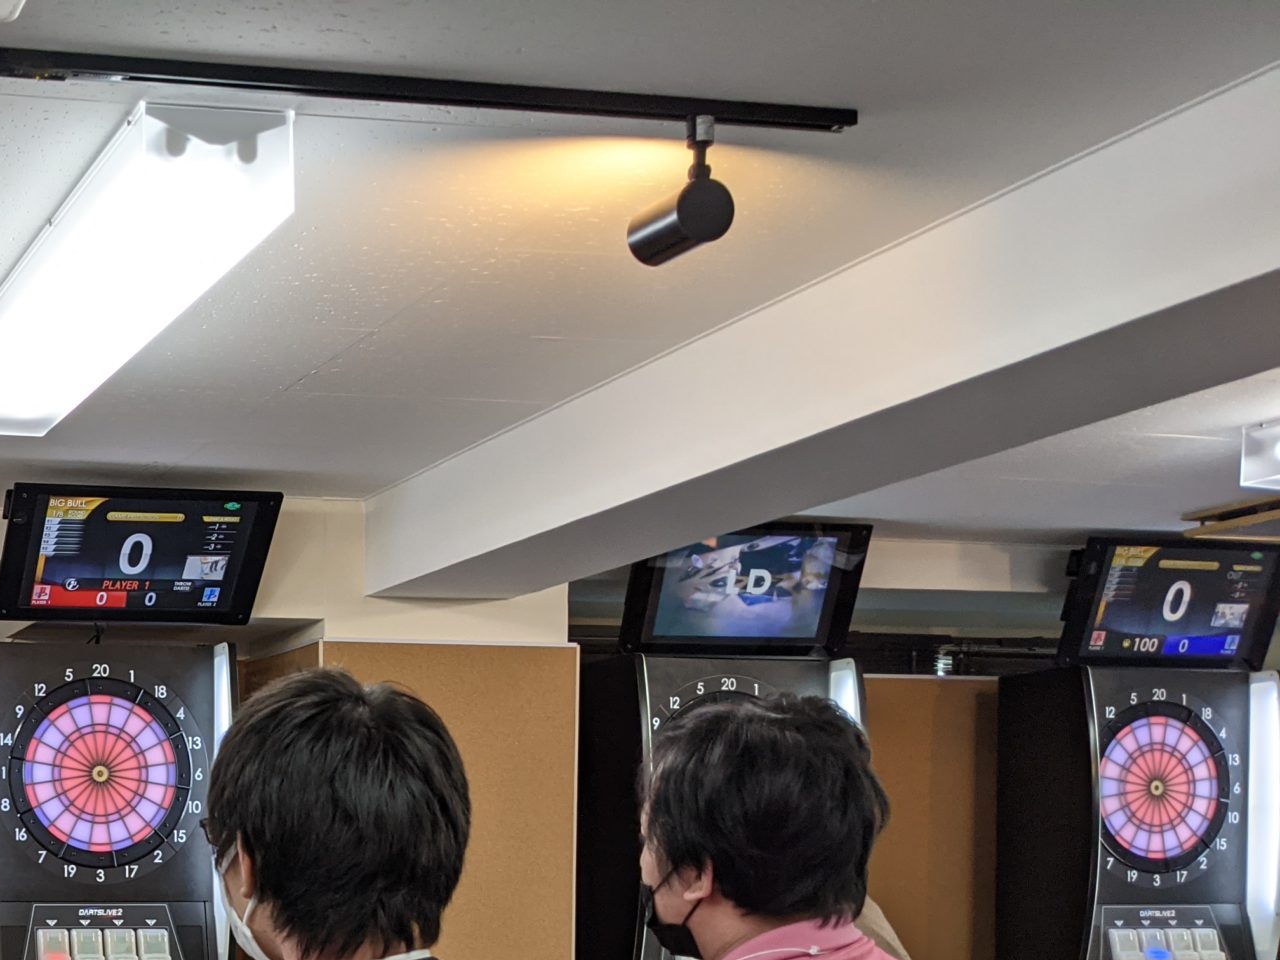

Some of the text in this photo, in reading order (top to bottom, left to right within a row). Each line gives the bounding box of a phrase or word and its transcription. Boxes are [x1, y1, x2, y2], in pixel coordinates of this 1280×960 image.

[49, 499, 87, 508] BIG BULL
[119, 533, 153, 575] 0
[102, 580, 150, 590] PLAYER 1
[95, 591, 107, 605] 0
[144, 592, 157, 606] 0
[1162, 580, 1191, 622] 0
[1133, 637, 1158, 652] 100
[1178, 639, 1188, 653] 0
[65, 669, 73, 681] 5
[92, 664, 109, 676] 20
[130, 670, 134, 682] 1
[35, 684, 46, 696] 12
[697, 683, 704, 694] 5
[721, 678, 736, 690] 20
[754, 684, 758, 695] 1
[155, 685, 166, 698] 18
[1152, 689, 1166, 700] 20
[670, 697, 680, 708] 12
[1130, 693, 1137, 704] 5
[1182, 694, 1186, 705] 1
[16, 705, 24, 718] 9
[176, 707, 184, 719] 4
[1106, 707, 1115, 718] 12
[1202, 708, 1212, 721] 18
[653, 718, 660, 729] 9
[0, 733, 12, 745] 14
[1219, 728, 1226, 738] 4
[189, 737, 201, 749] 13
[1229, 754, 1239, 765] 13
[195, 768, 203, 780] 6
[1234, 782, 1240, 794] 6
[1, 798, 10, 811] 8
[189, 801, 201, 813] 10
[1229, 812, 1239, 823] 10
[15, 828, 27, 840] 16
[174, 830, 186, 842] 15
[1217, 838, 1226, 850] 15
[39, 851, 46, 863] 7
[154, 850, 162, 862] 2
[1107, 858, 1114, 869] 7
[1198, 856, 1207, 869] 2
[64, 865, 76, 877] 19
[96, 869, 104, 882] 3
[126, 865, 138, 877] 17
[1128, 870, 1137, 881] 19
[1177, 871, 1187, 882] 17
[1153, 875, 1160, 886] 3
